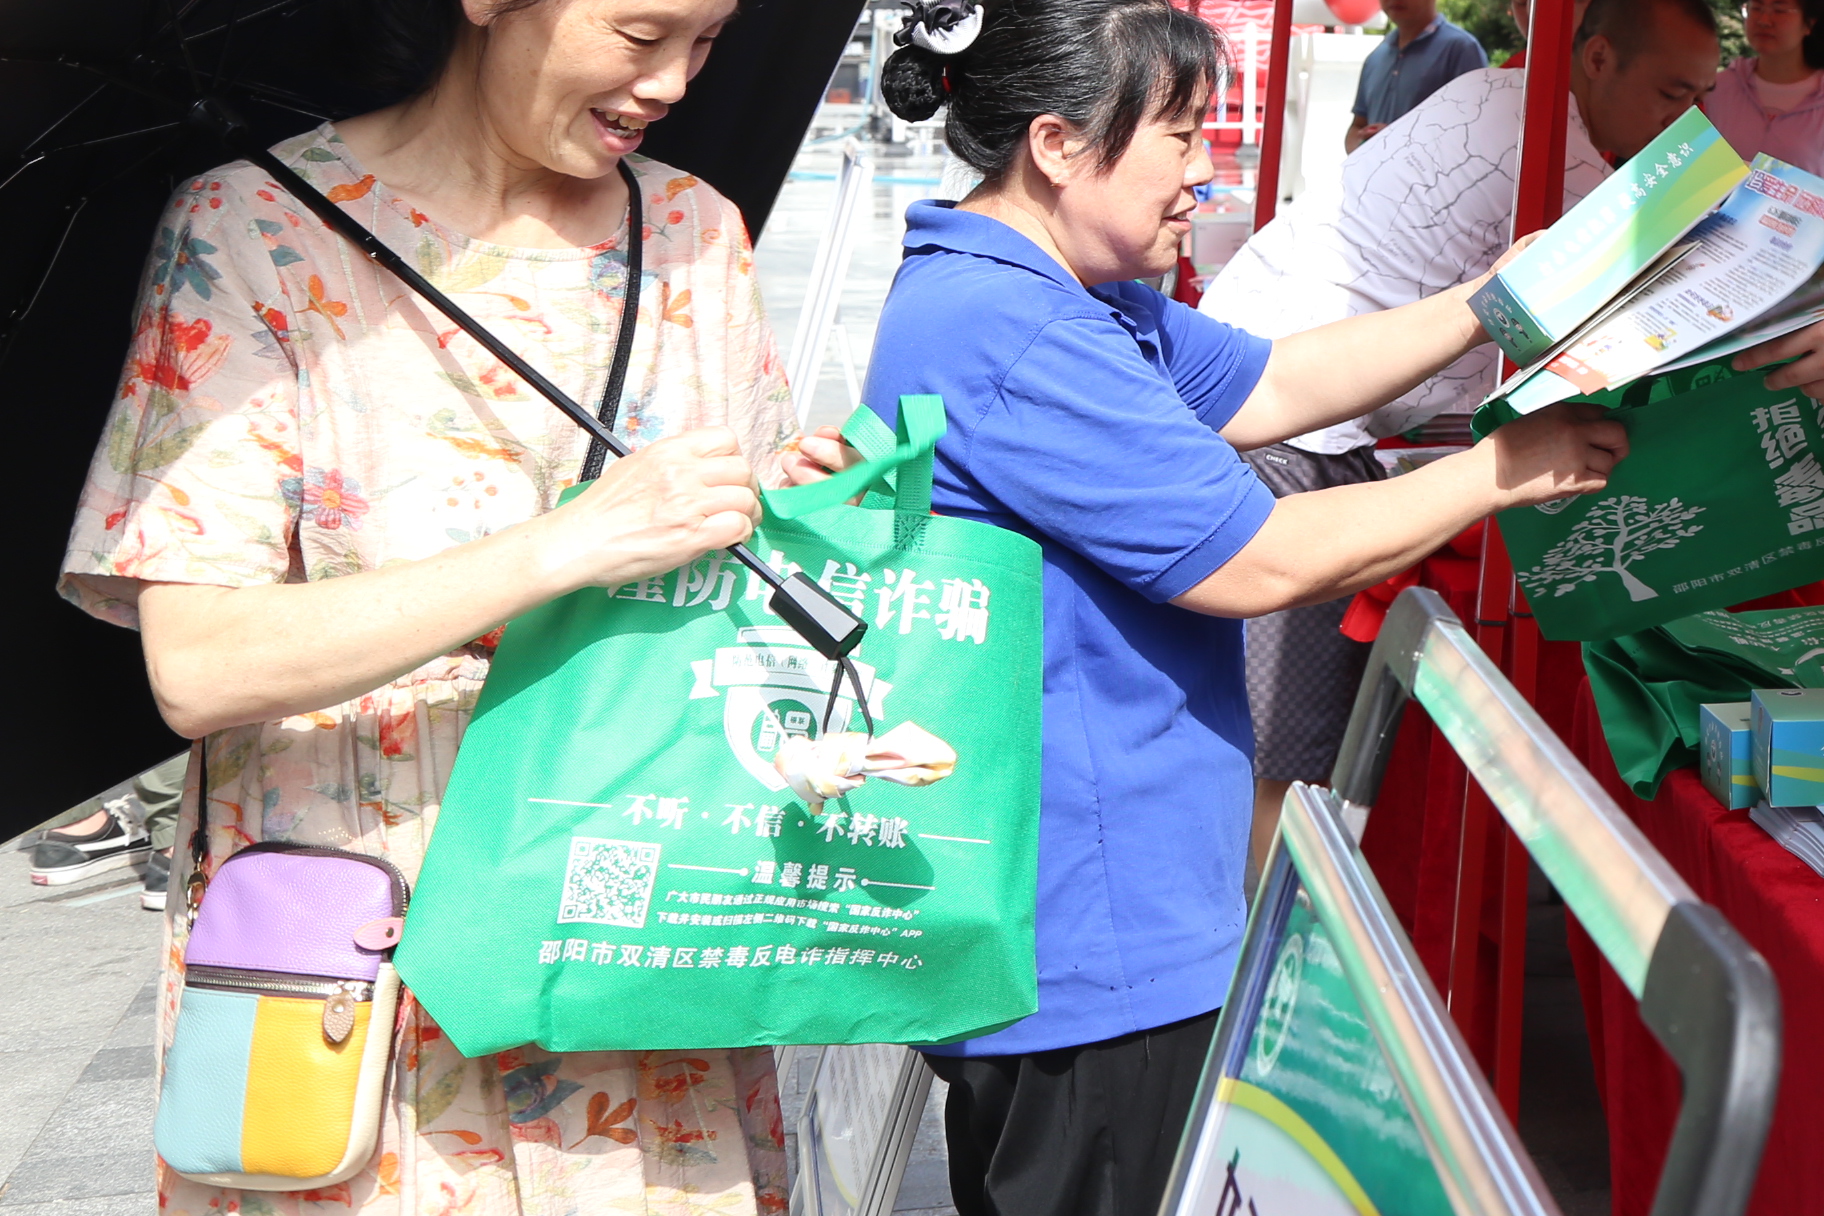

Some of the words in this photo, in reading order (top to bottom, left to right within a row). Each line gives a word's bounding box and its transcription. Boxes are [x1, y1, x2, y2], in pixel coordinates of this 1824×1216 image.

[750, 859, 859, 893] 温馨提示
[538, 937, 924, 971] 邵阳市双清区禁毒反电诈指挥中心
